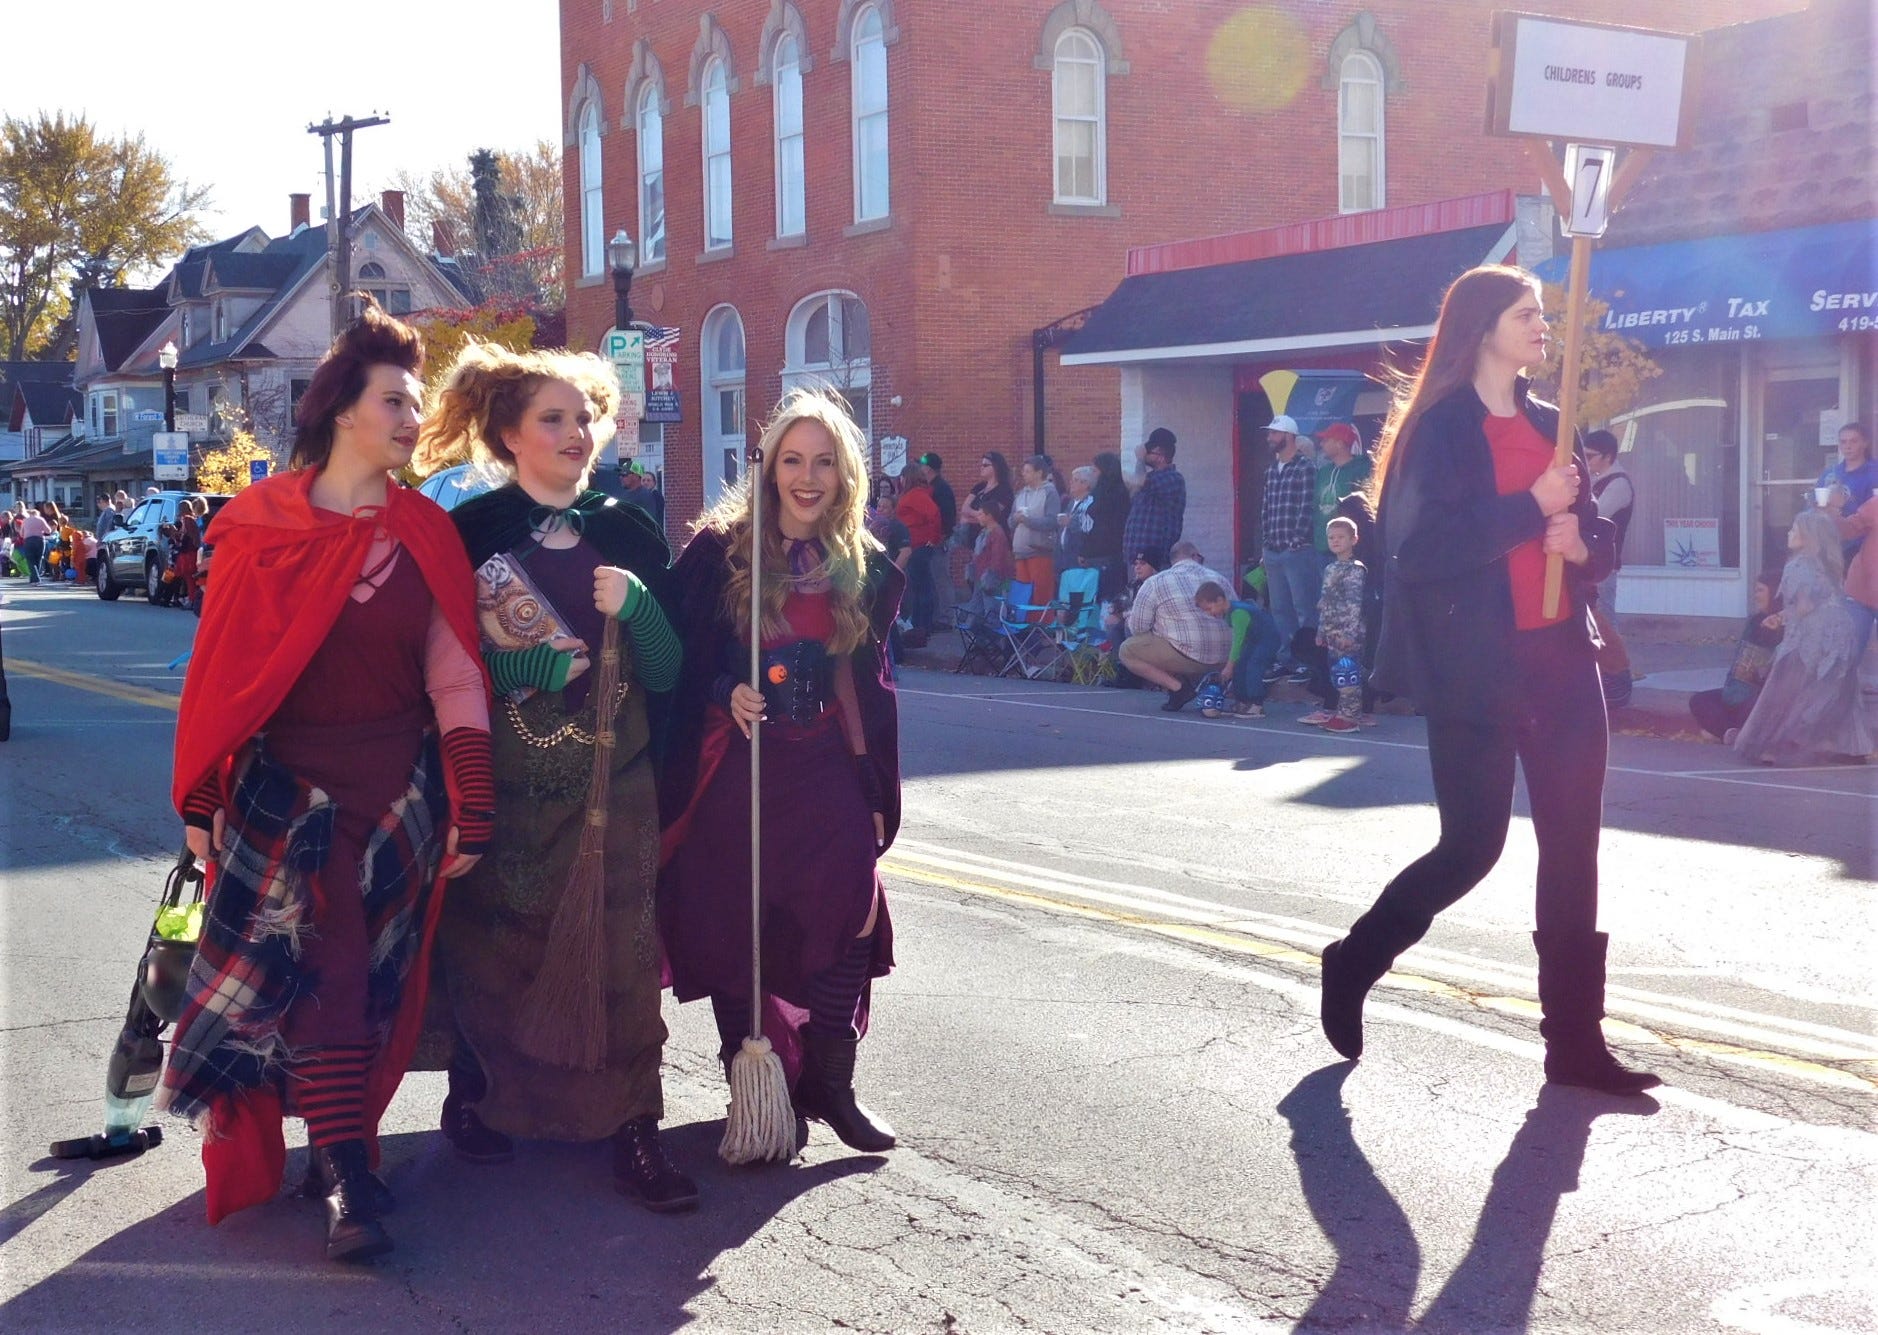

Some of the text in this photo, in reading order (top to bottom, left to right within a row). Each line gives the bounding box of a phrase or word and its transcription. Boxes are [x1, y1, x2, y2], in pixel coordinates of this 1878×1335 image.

[1544, 65, 1643, 90] CHILDRENS GROUPS
[1579, 158, 1604, 218] 7
[1727, 298, 1771, 318] TAX
[1664, 325, 1761, 345] 125 S. Main St.
